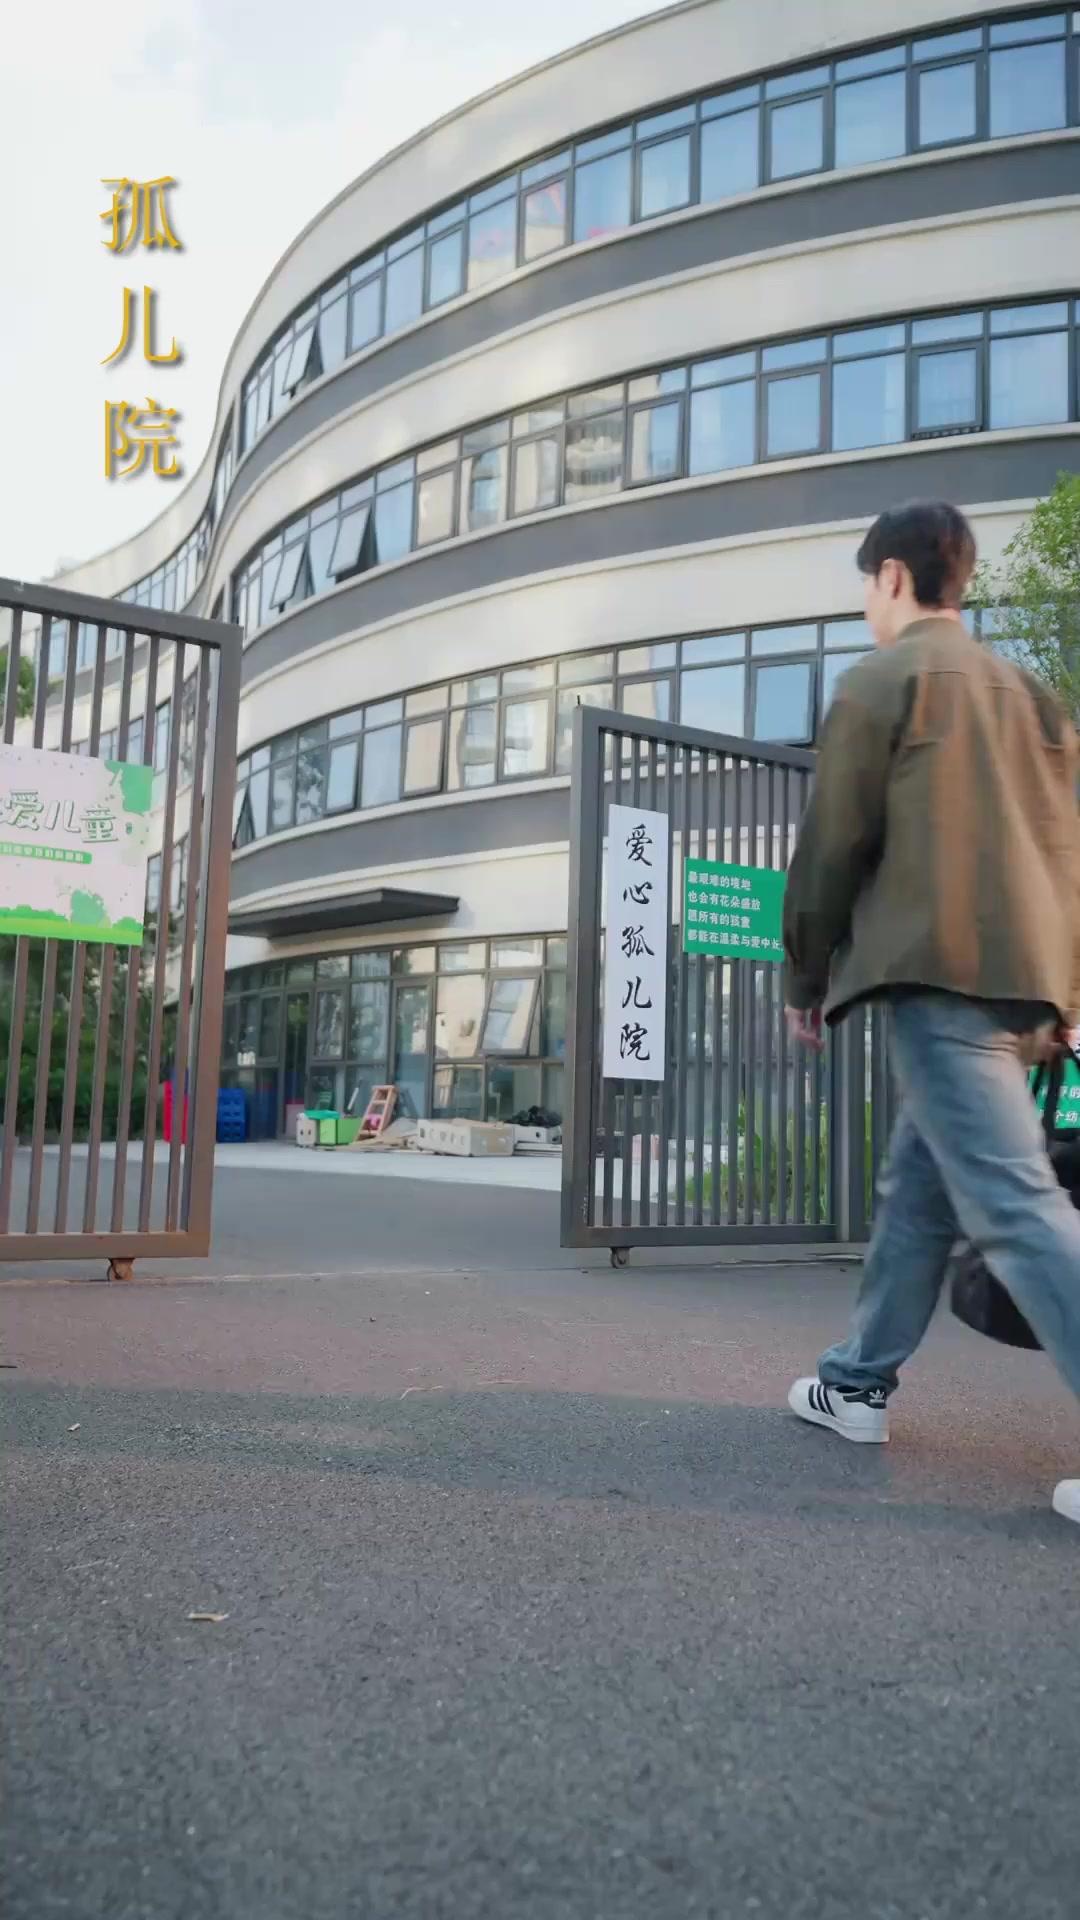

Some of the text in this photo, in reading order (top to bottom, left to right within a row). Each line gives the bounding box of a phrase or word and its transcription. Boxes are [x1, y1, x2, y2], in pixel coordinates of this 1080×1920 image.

[619, 823, 655, 1061] 爱心孤儿院
